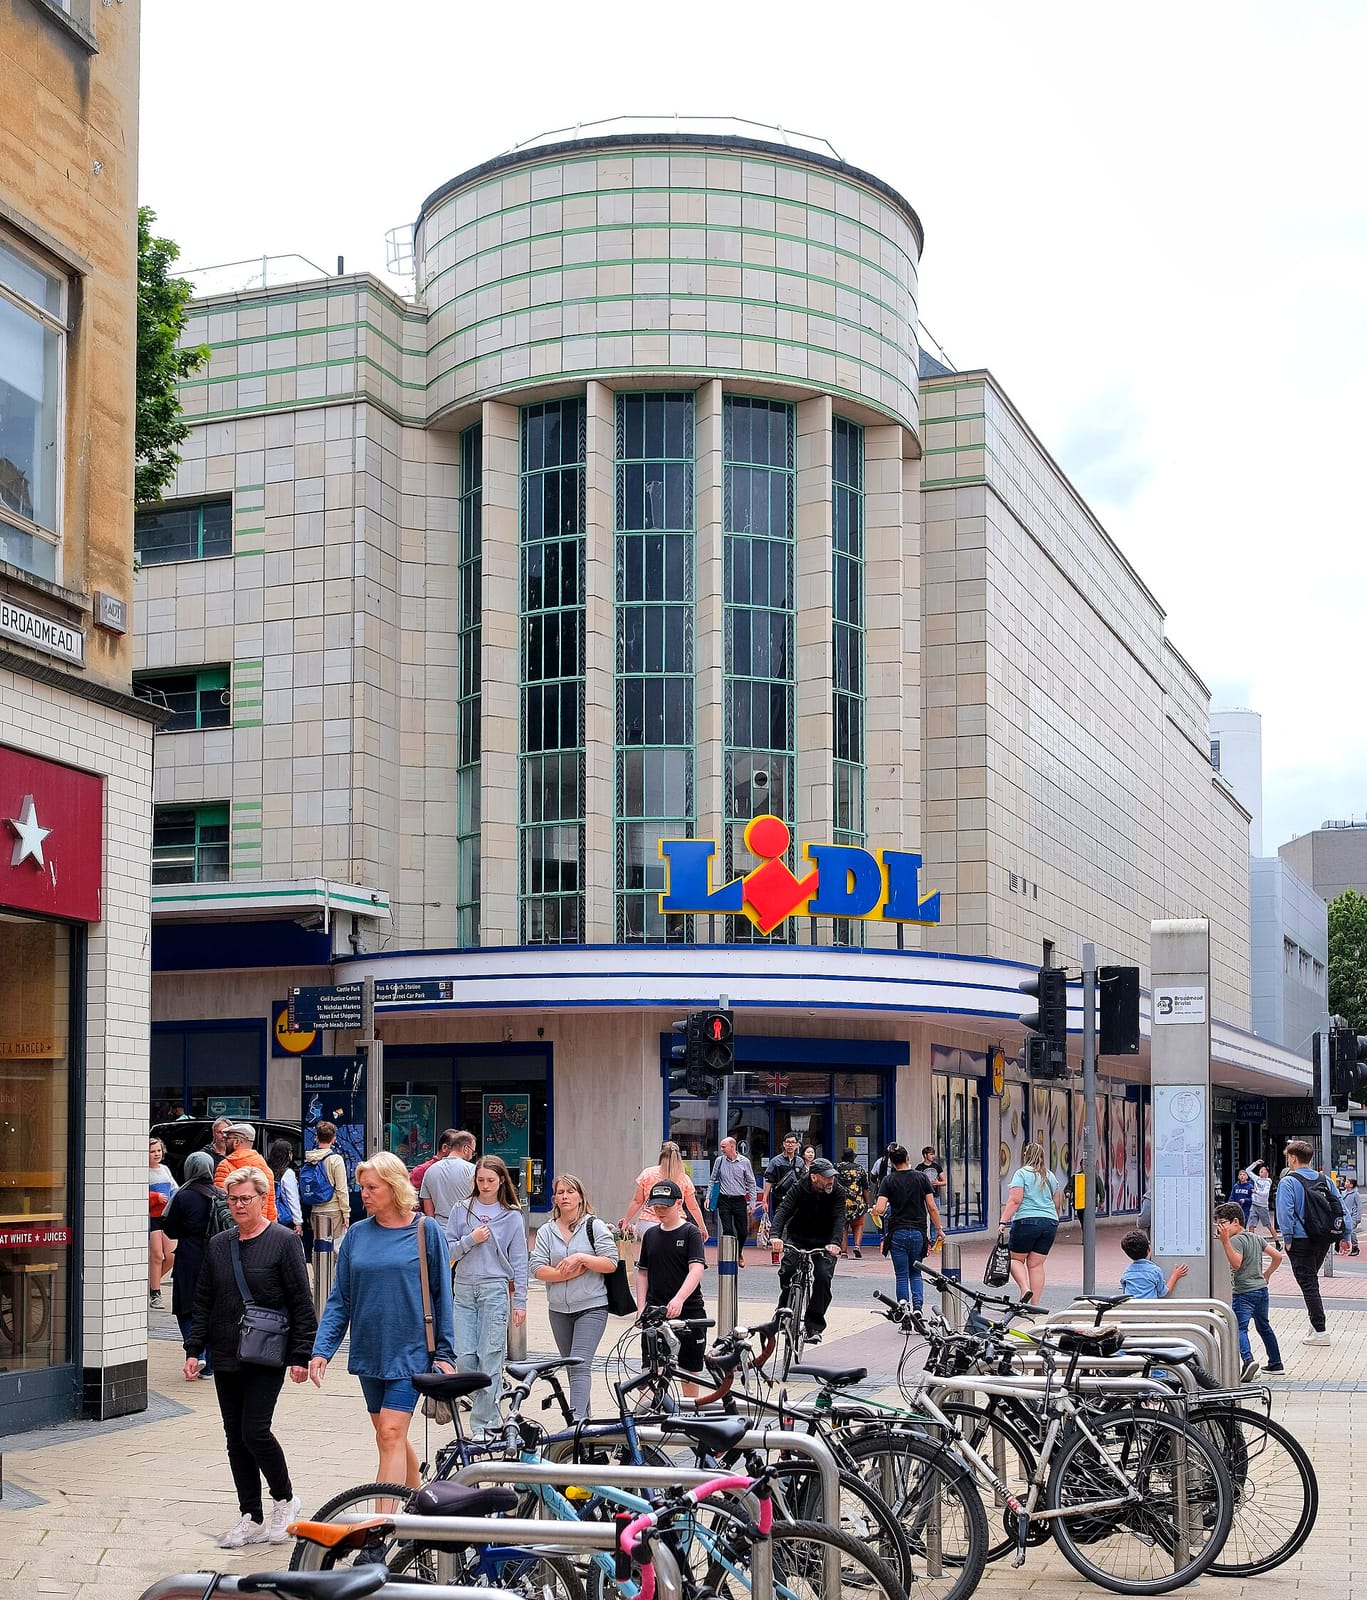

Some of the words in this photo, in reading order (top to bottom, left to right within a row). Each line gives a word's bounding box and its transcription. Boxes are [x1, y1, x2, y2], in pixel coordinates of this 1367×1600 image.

[340, 1012, 361, 1020] Shopping
[344, 1021, 361, 1029] Station
[488, 1104, 504, 1114] £28
[10, 1233, 33, 1244] WHITE
[42, 1231, 67, 1242] JUICES
